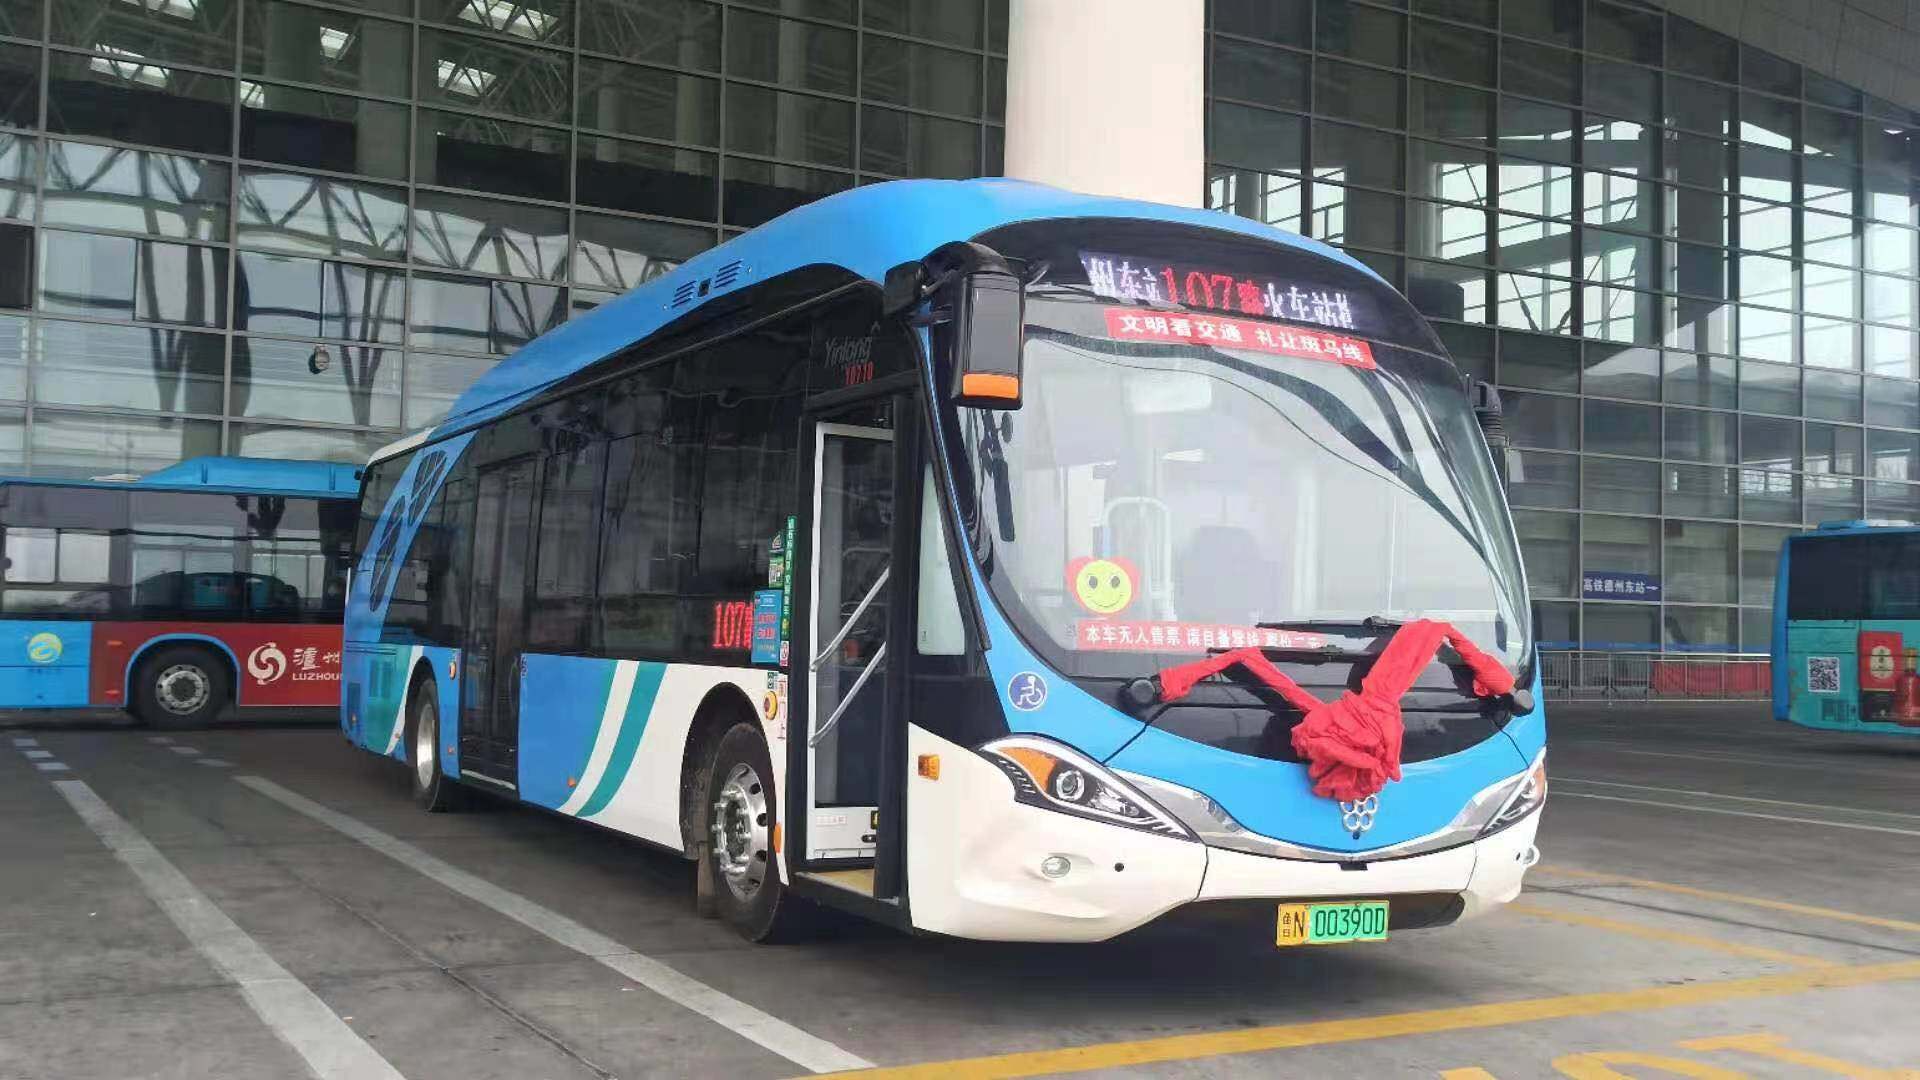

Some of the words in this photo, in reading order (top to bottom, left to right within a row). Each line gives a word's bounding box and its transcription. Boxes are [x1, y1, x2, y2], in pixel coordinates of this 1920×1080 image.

[1583, 578, 1646, 594] 高铁德州东站
